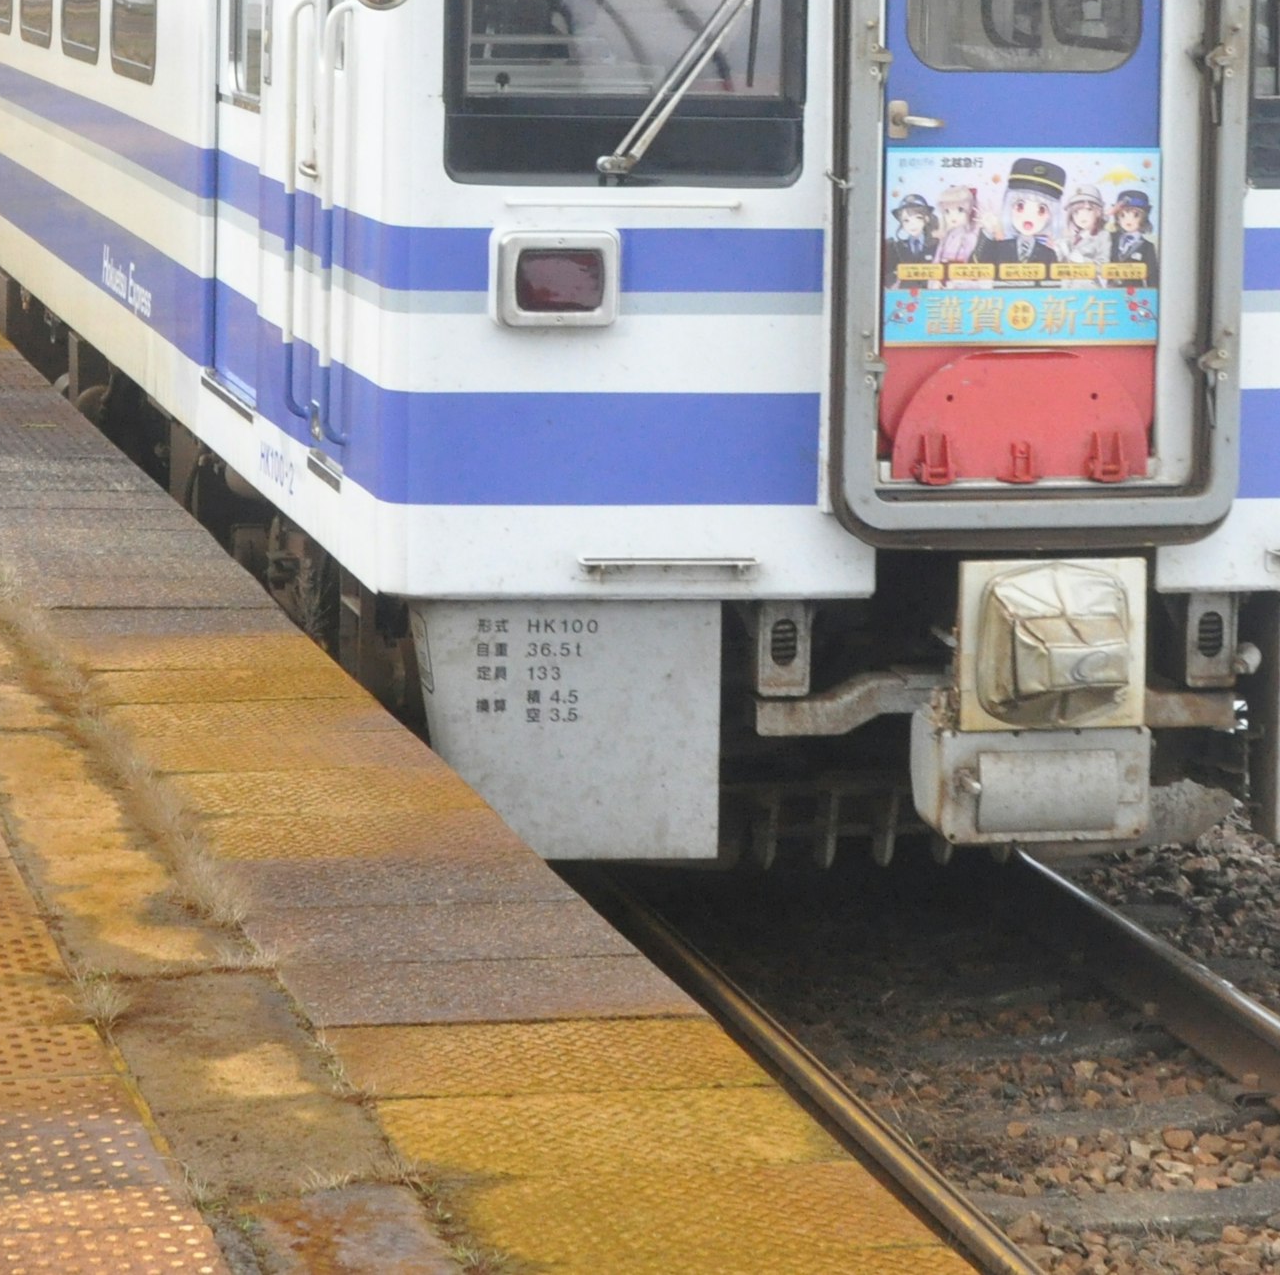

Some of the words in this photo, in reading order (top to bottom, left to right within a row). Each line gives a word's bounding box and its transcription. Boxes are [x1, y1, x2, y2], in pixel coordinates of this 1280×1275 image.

[940, 157, 983, 169] 北越急行
[128, 261, 152, 318] Express
[925, 296, 1004, 336] 謹賀
[1039, 296, 1119, 335] 新年
[477, 618, 509, 633] 形式
[527, 619, 598, 633] HK100
[476, 642, 508, 657] 自重
[476, 666, 507, 680] 定員
[527, 666, 561, 681] 133
[550, 689, 578, 704] 4.5
[526, 708, 540, 723] 空
[550, 707, 578, 722] 3.5
